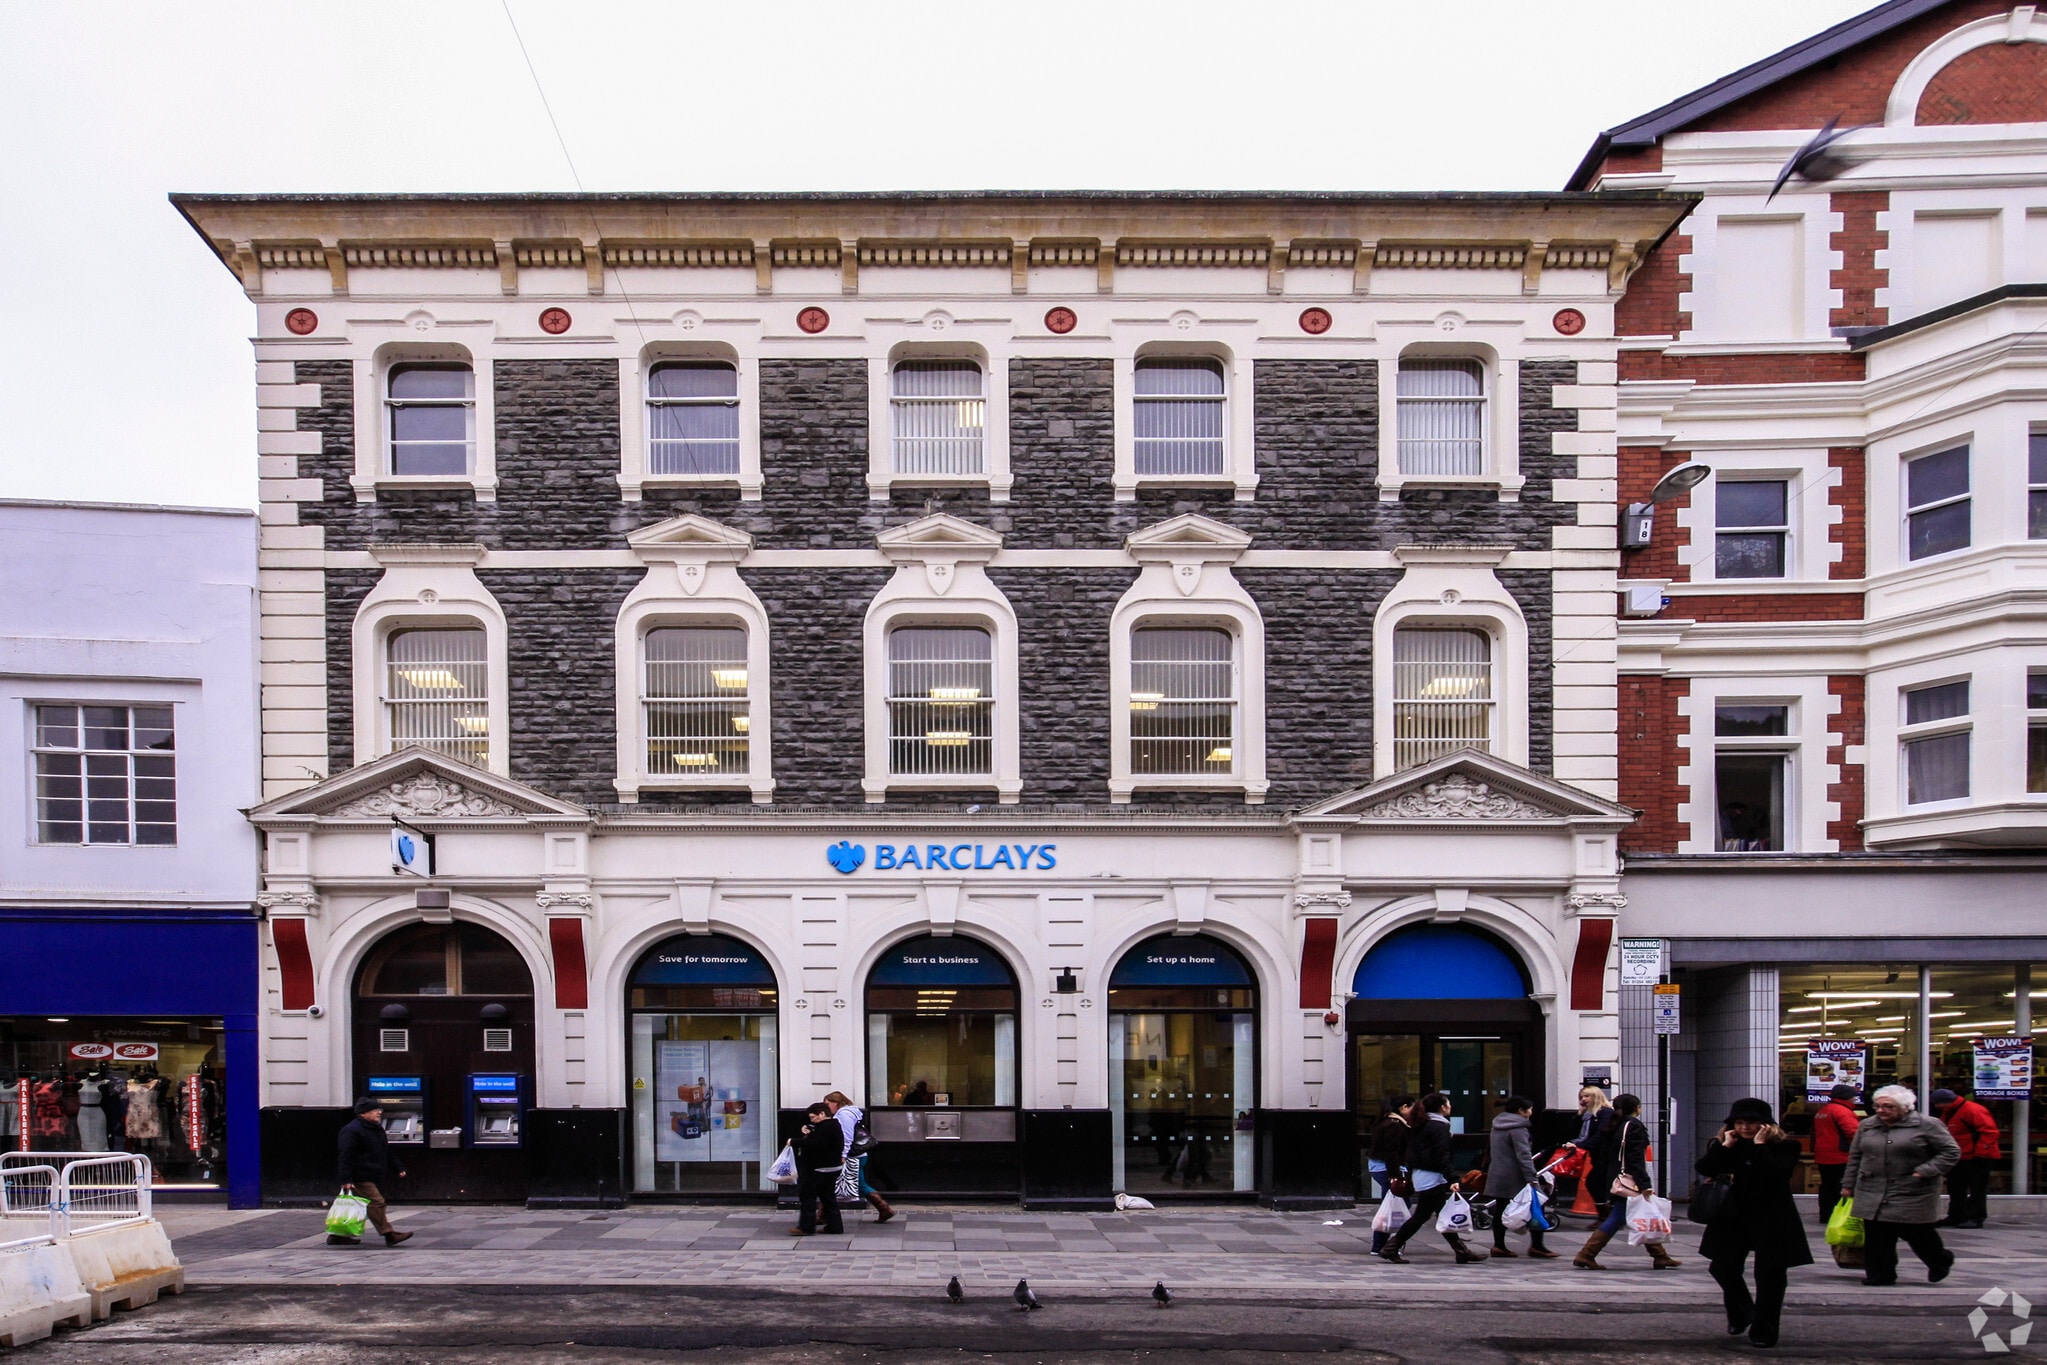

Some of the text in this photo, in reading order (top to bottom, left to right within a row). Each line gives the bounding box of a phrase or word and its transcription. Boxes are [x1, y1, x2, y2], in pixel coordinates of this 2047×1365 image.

[875, 844, 1056, 870] BARCLAYS
[659, 955, 682, 963] Save
[685, 955, 699, 964] for
[903, 956, 927, 964] Start
[939, 956, 979, 964] business
[1147, 955, 1163, 964] Set
[1165, 957, 1178, 965] up
[1189, 956, 1216, 964] home
[1819, 1041, 1856, 1052] WOW!
[1984, 1039, 2023, 1049] WOW!
[78, 1045, 104, 1054] Sale
[123, 1045, 148, 1055] Sale
